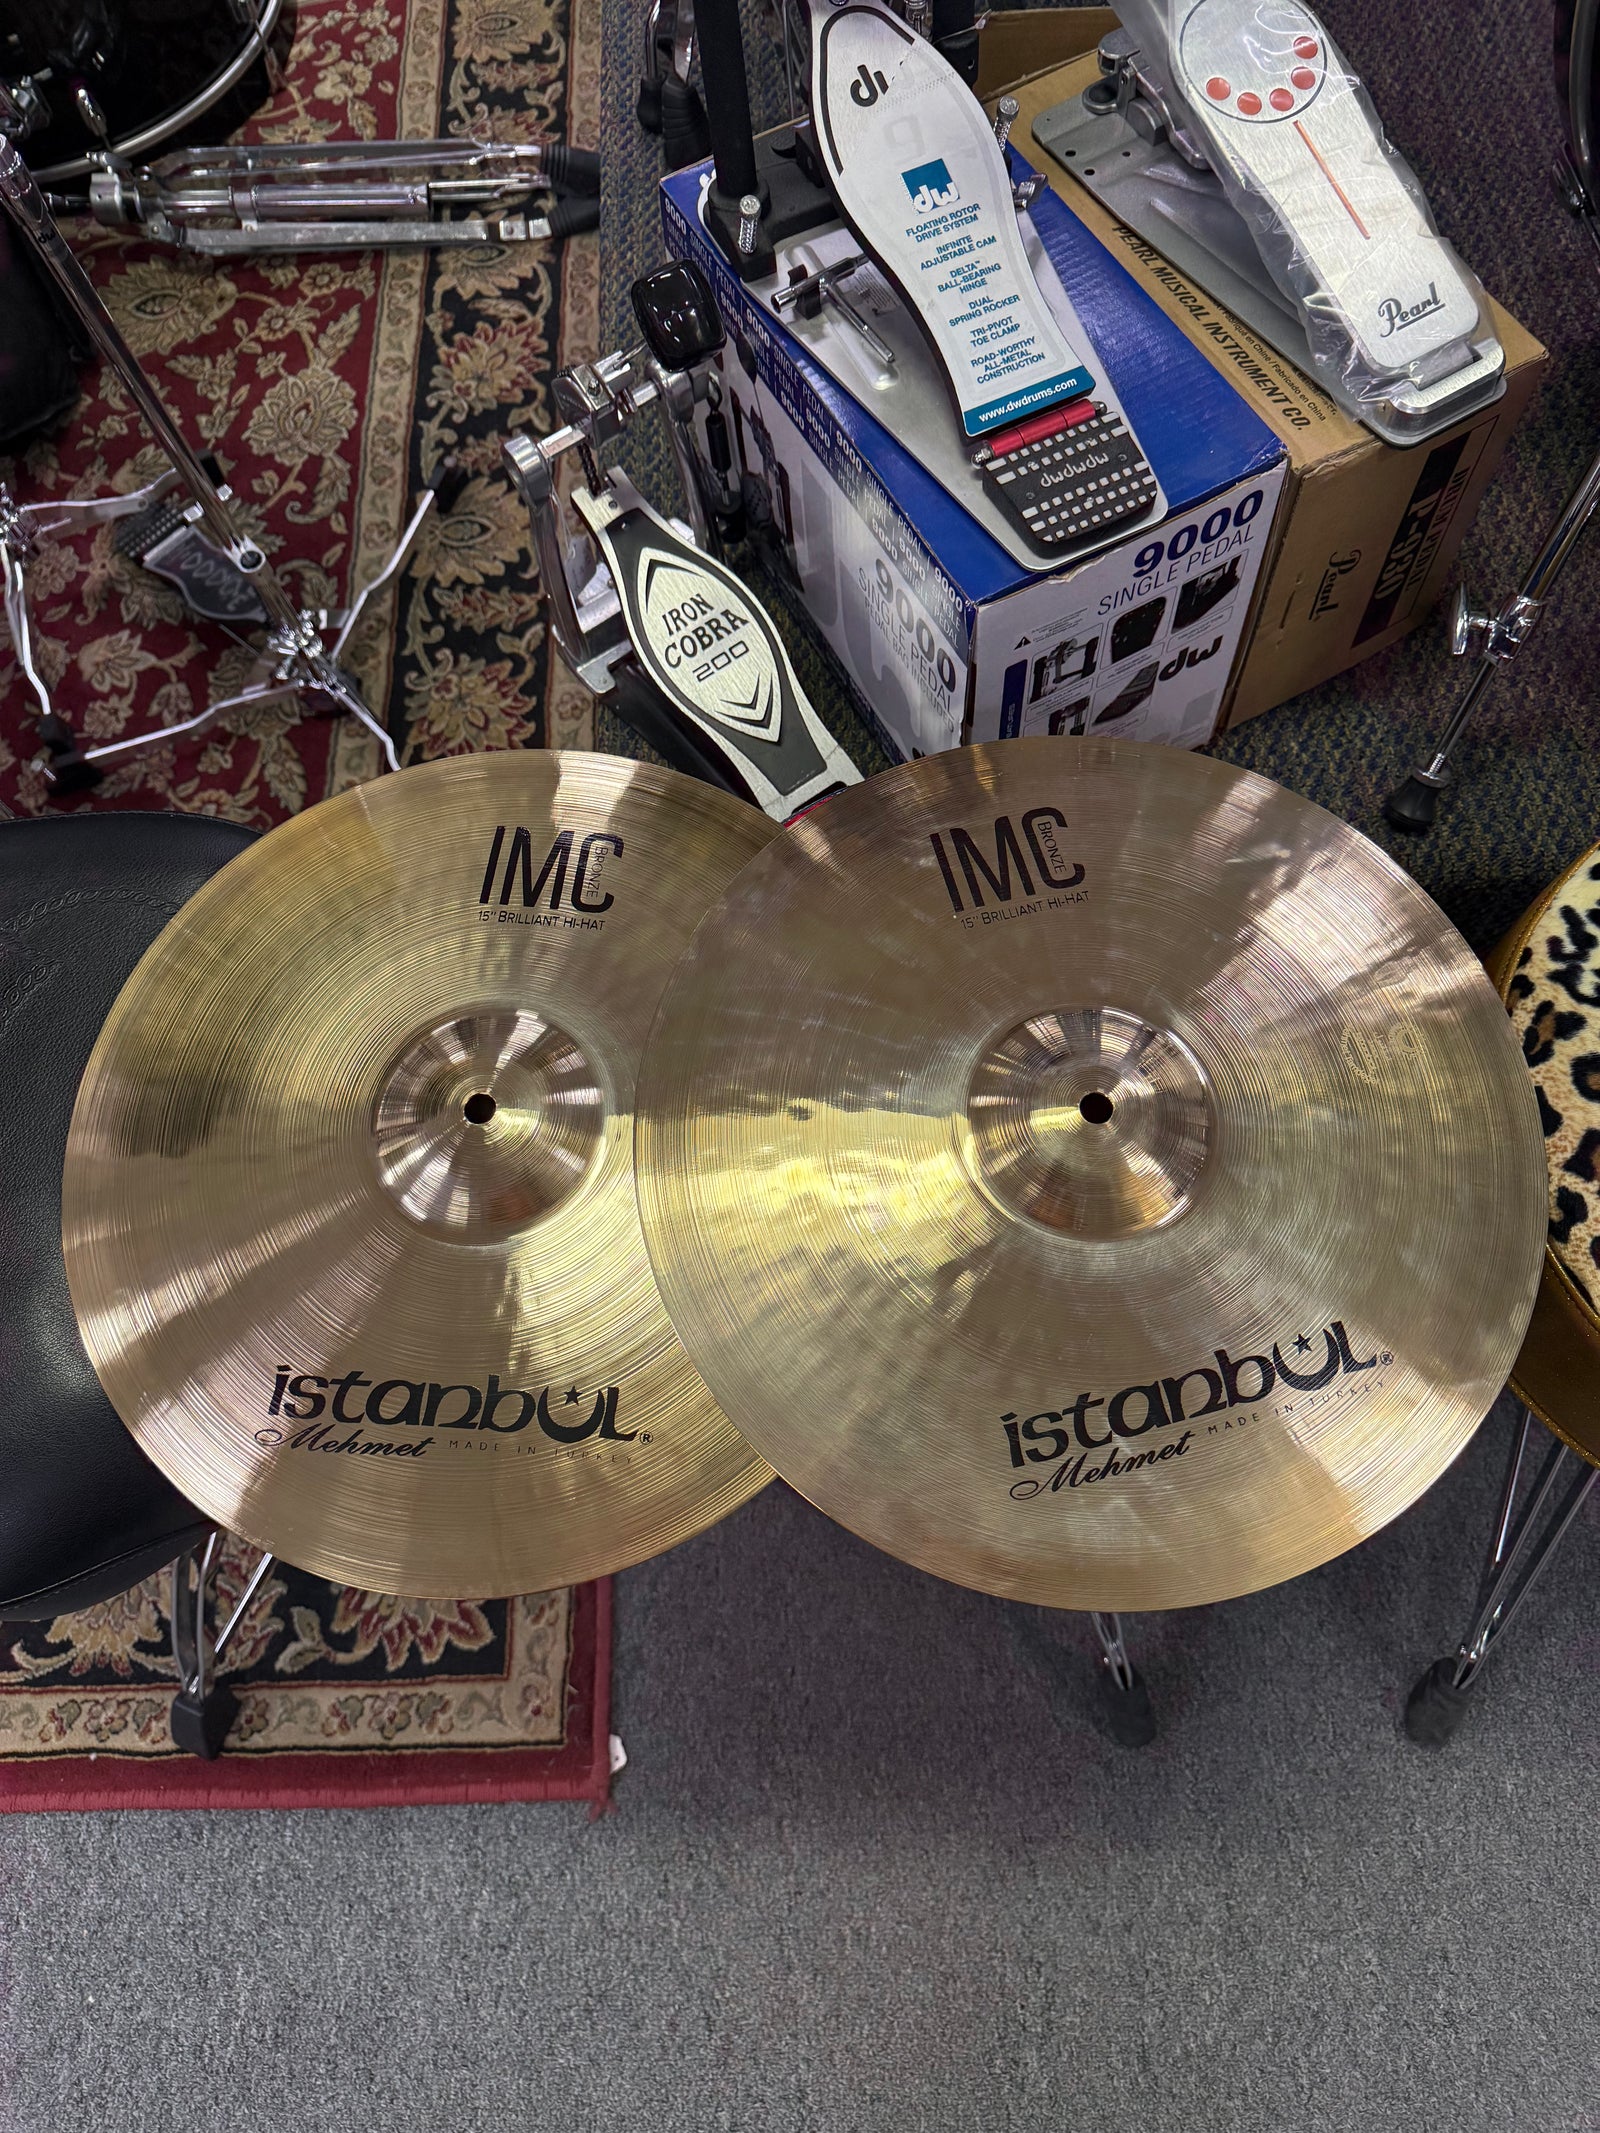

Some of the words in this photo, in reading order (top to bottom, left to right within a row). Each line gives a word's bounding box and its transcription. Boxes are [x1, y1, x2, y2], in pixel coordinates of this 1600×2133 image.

[906, 212, 949, 238] FLOATING
[949, 203, 982, 221] ROTOR
[914, 182, 961, 214] dw
[915, 226, 944, 244] DRIVE
[944, 213, 979, 234] SYSTEM
[936, 234, 974, 255] INFINITE
[920, 244, 977, 271] ADJUSTABLE
[976, 235, 998, 250] CAM
[937, 262, 1002, 293] BALL-BEARING
[959, 277, 988, 295] HINGE
[949, 309, 984, 327] SPRING
[984, 294, 1021, 315] ROCKER
[968, 296, 994, 311] DUAL
[1378, 281, 1443, 338] Pearl
[970, 316, 1014, 338] TRI-PIVOT
[970, 336, 990, 349] TOE
[989, 323, 1021, 341] CLAMP
[1112, 225, 1159, 268] PEARL
[1151, 265, 1211, 323] MUSICAL
[1202, 320, 1293, 405] INSTRUMENT
[1281, 406, 1312, 431] CO.
[970, 336, 1036, 368] ROAD-WORTHY
[976, 352, 1046, 385] CONSTRUCTION
[983, 349, 1032, 373] ALL-METAL
[665, 196, 687, 236] 9000
[746, 308, 770, 349] 9000
[773, 344, 799, 388] SINGLE
[802, 385, 826, 426] PEDAL
[836, 430, 863, 474] 9000
[866, 470, 894, 518] SINGLE
[897, 514, 924, 556] PEDAL
[934, 566, 964, 613] 9000
[978, 377, 1078, 423] www.dwdrums.com
[1252, 343, 1273, 367] Chine
[1272, 364, 1302, 399] Fabricado
[1299, 394, 1310, 404] en
[1307, 401, 1327, 422] China
[720, 290, 744, 329] 9000
[805, 407, 831, 448] 9000
[834, 446, 861, 487] SINGLE
[864, 486, 888, 528] PEDAL
[899, 537, 926, 582] 9000
[931, 583, 963, 633] SINGLE
[780, 391, 806, 432] 9000
[808, 428, 834, 472] SINGLE
[872, 518, 898, 561] 9000
[934, 605, 959, 649] PEDAL
[1133, 489, 1264, 579] 9000
[1373, 487, 1443, 601] P-930
[1097, 560, 1181, 616] SINGLE
[1185, 524, 1255, 573] PEDAL
[1311, 549, 1362, 618] Pearl
[661, 593, 714, 637] IRON
[864, 596, 890, 643] PEDAL
[875, 558, 956, 693] 9000
[664, 608, 750, 670] COBRA
[692, 640, 750, 683] 200
[859, 567, 906, 646] SINGLE
[911, 642, 955, 721] PEDAL
[1158, 634, 1224, 682] dw
[479, 825, 625, 914] IMC
[929, 806, 1086, 913] IMC
[1037, 820, 1067, 875] BRONZE
[586, 845, 609, 898] BRONZE
[497, 910, 560, 928] BRILLIANT
[563, 917, 606, 931] HI-HAT
[980, 900, 1044, 926] BRILLIANT
[1047, 890, 1090, 910] HI-HAT
[1207, 1411, 1261, 1436] MADE
[1275, 1403, 1295, 1416] IN
[1308, 1379, 1387, 1408] TURKEY
[254, 1423, 437, 1459] Mehmet
[449, 1438, 500, 1453] MADE
[517, 1445, 537, 1456] IN
[554, 1448, 635, 1466] TURKEY
[1009, 1429, 1197, 1501] Mehmet
